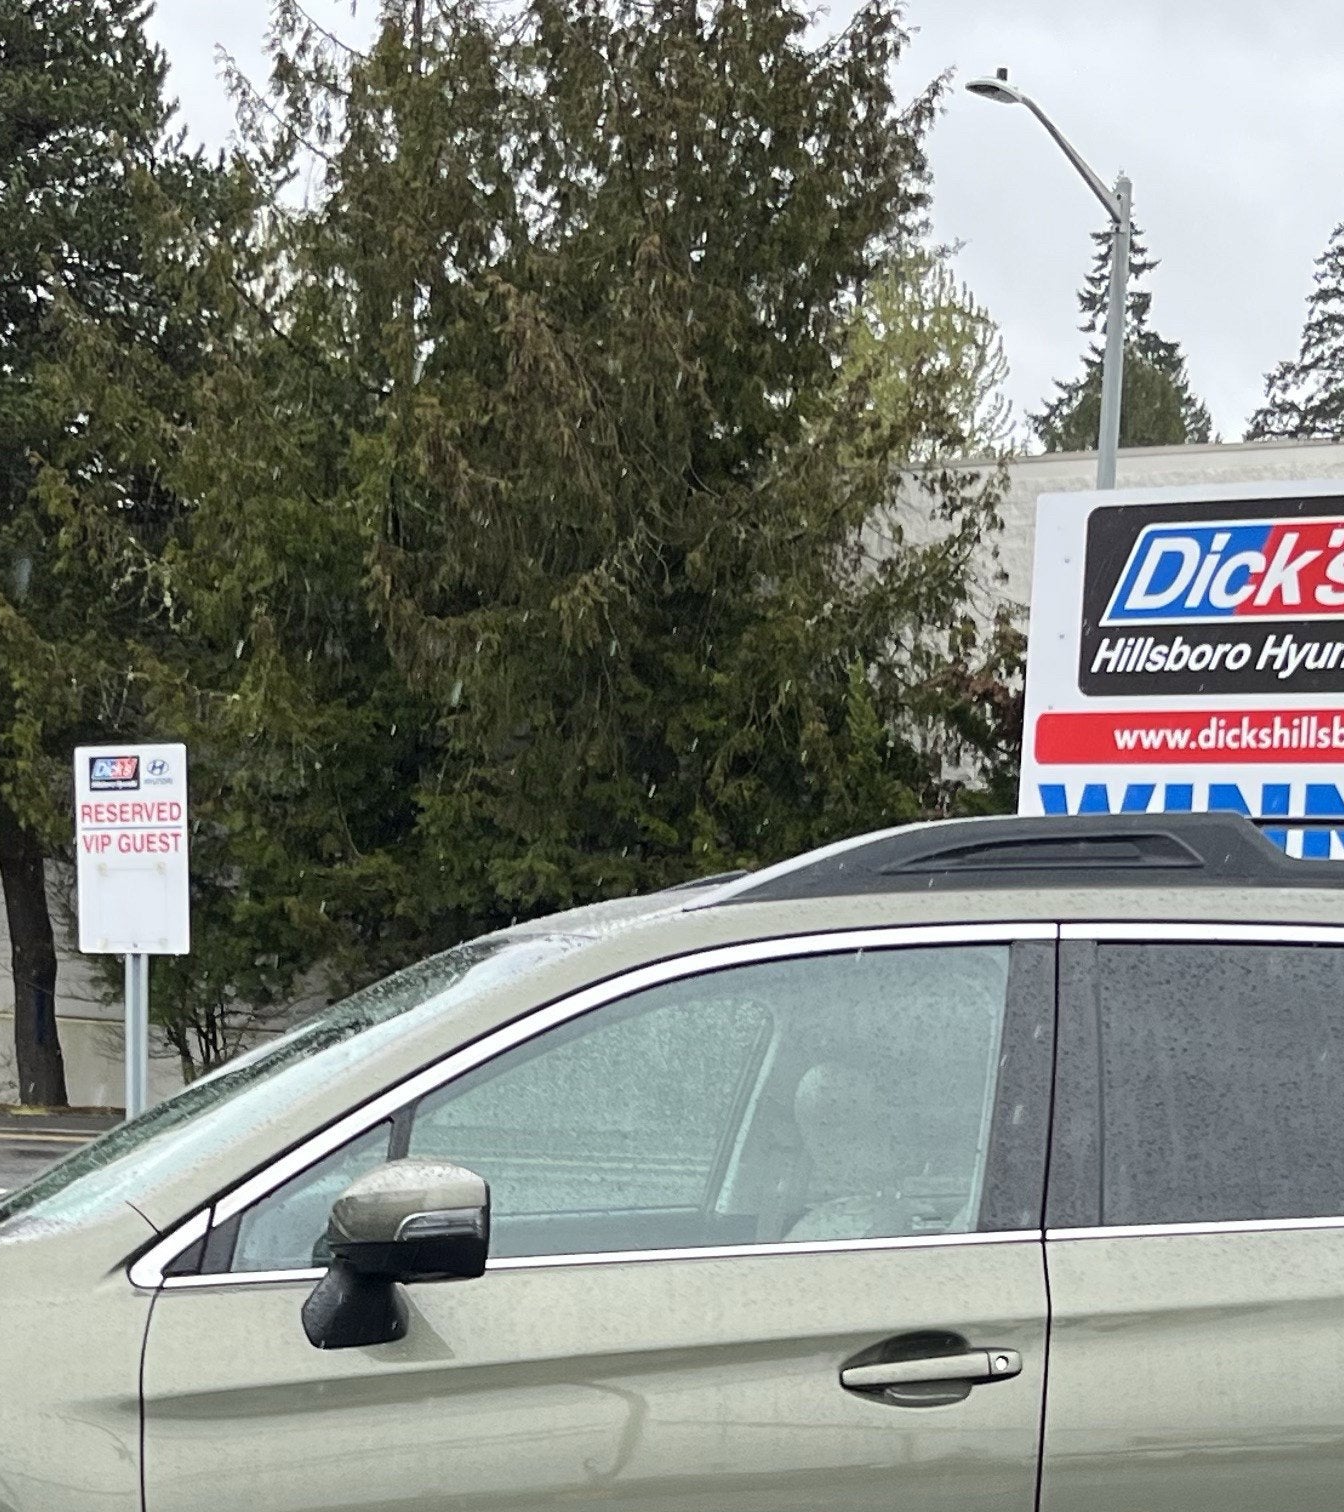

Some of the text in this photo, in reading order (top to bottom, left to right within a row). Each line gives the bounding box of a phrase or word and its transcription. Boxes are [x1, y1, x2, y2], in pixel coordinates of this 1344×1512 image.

[1091, 635, 1251, 673] Hillsboro
[81, 802, 181, 823] RESERVED
[83, 833, 181, 853] VIP GUEST
